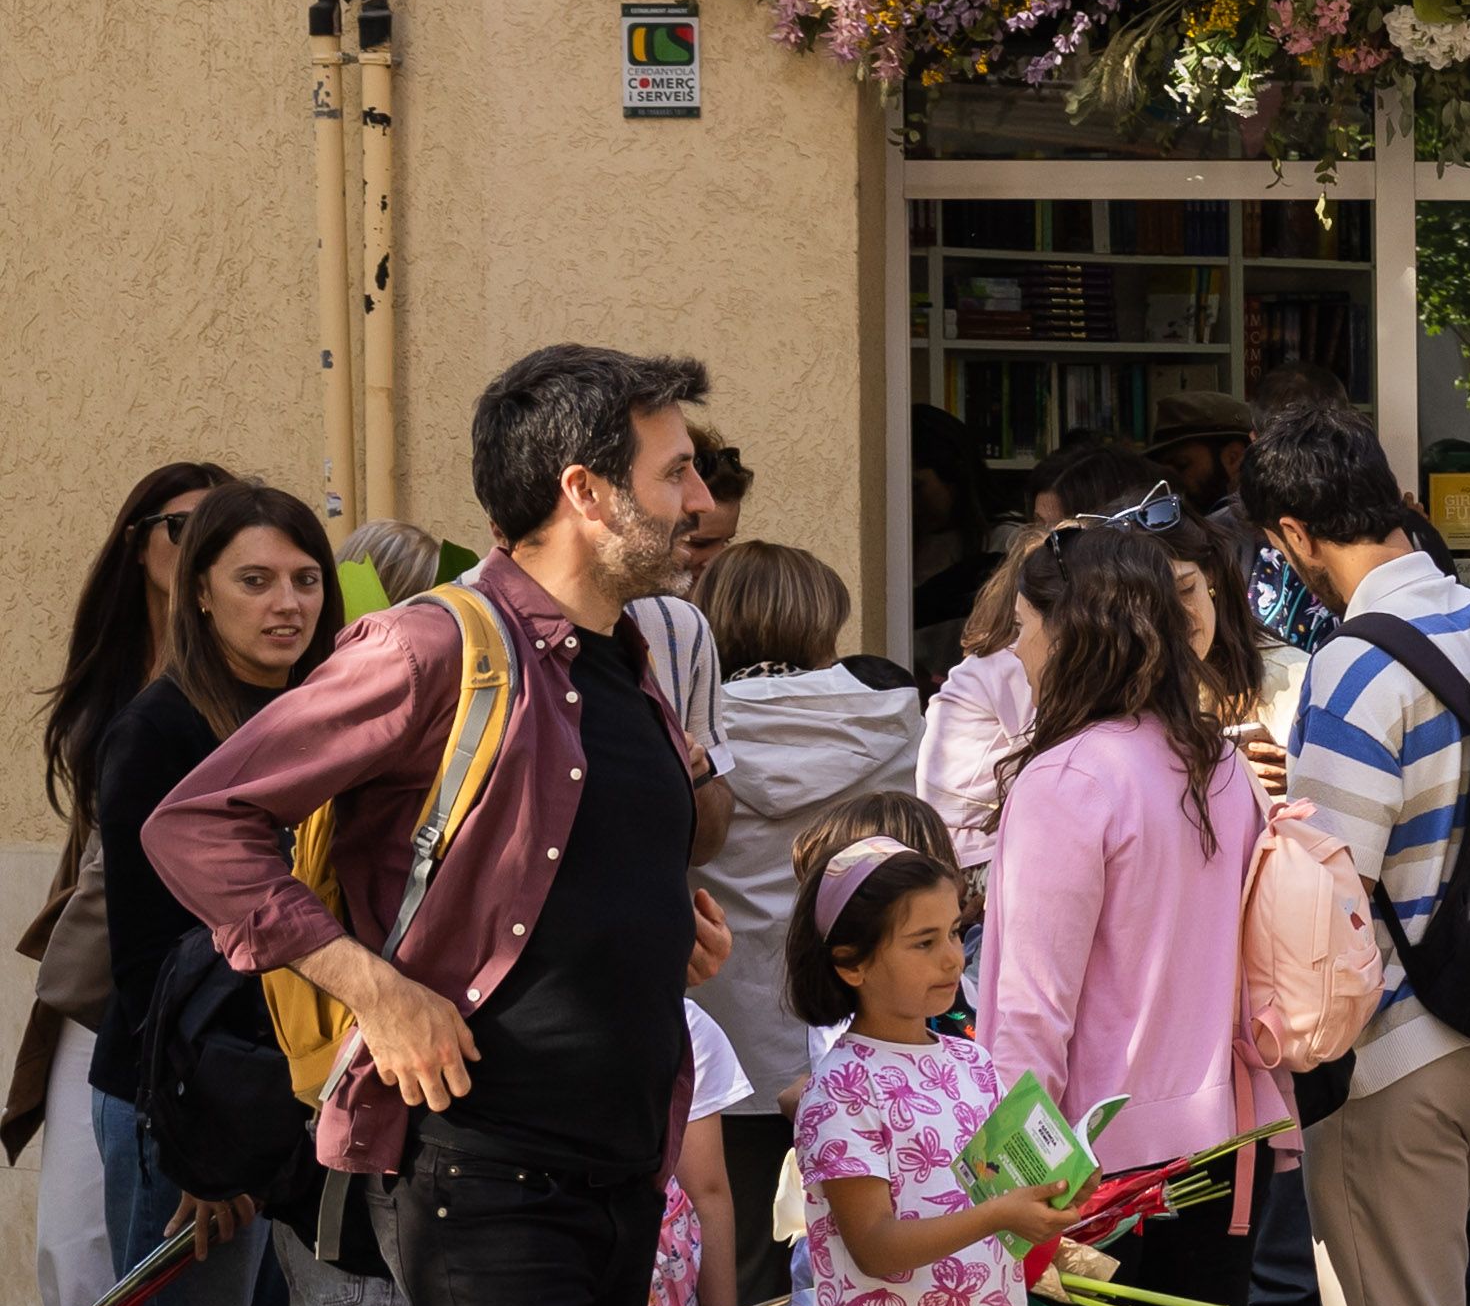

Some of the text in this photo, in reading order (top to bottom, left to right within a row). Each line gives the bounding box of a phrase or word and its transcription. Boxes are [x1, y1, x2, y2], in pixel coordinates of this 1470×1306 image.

[627, 68, 696, 76] CERDANYOLA
[628, 78, 695, 93] COMERÇ
[637, 92, 695, 102] SERVEIS
